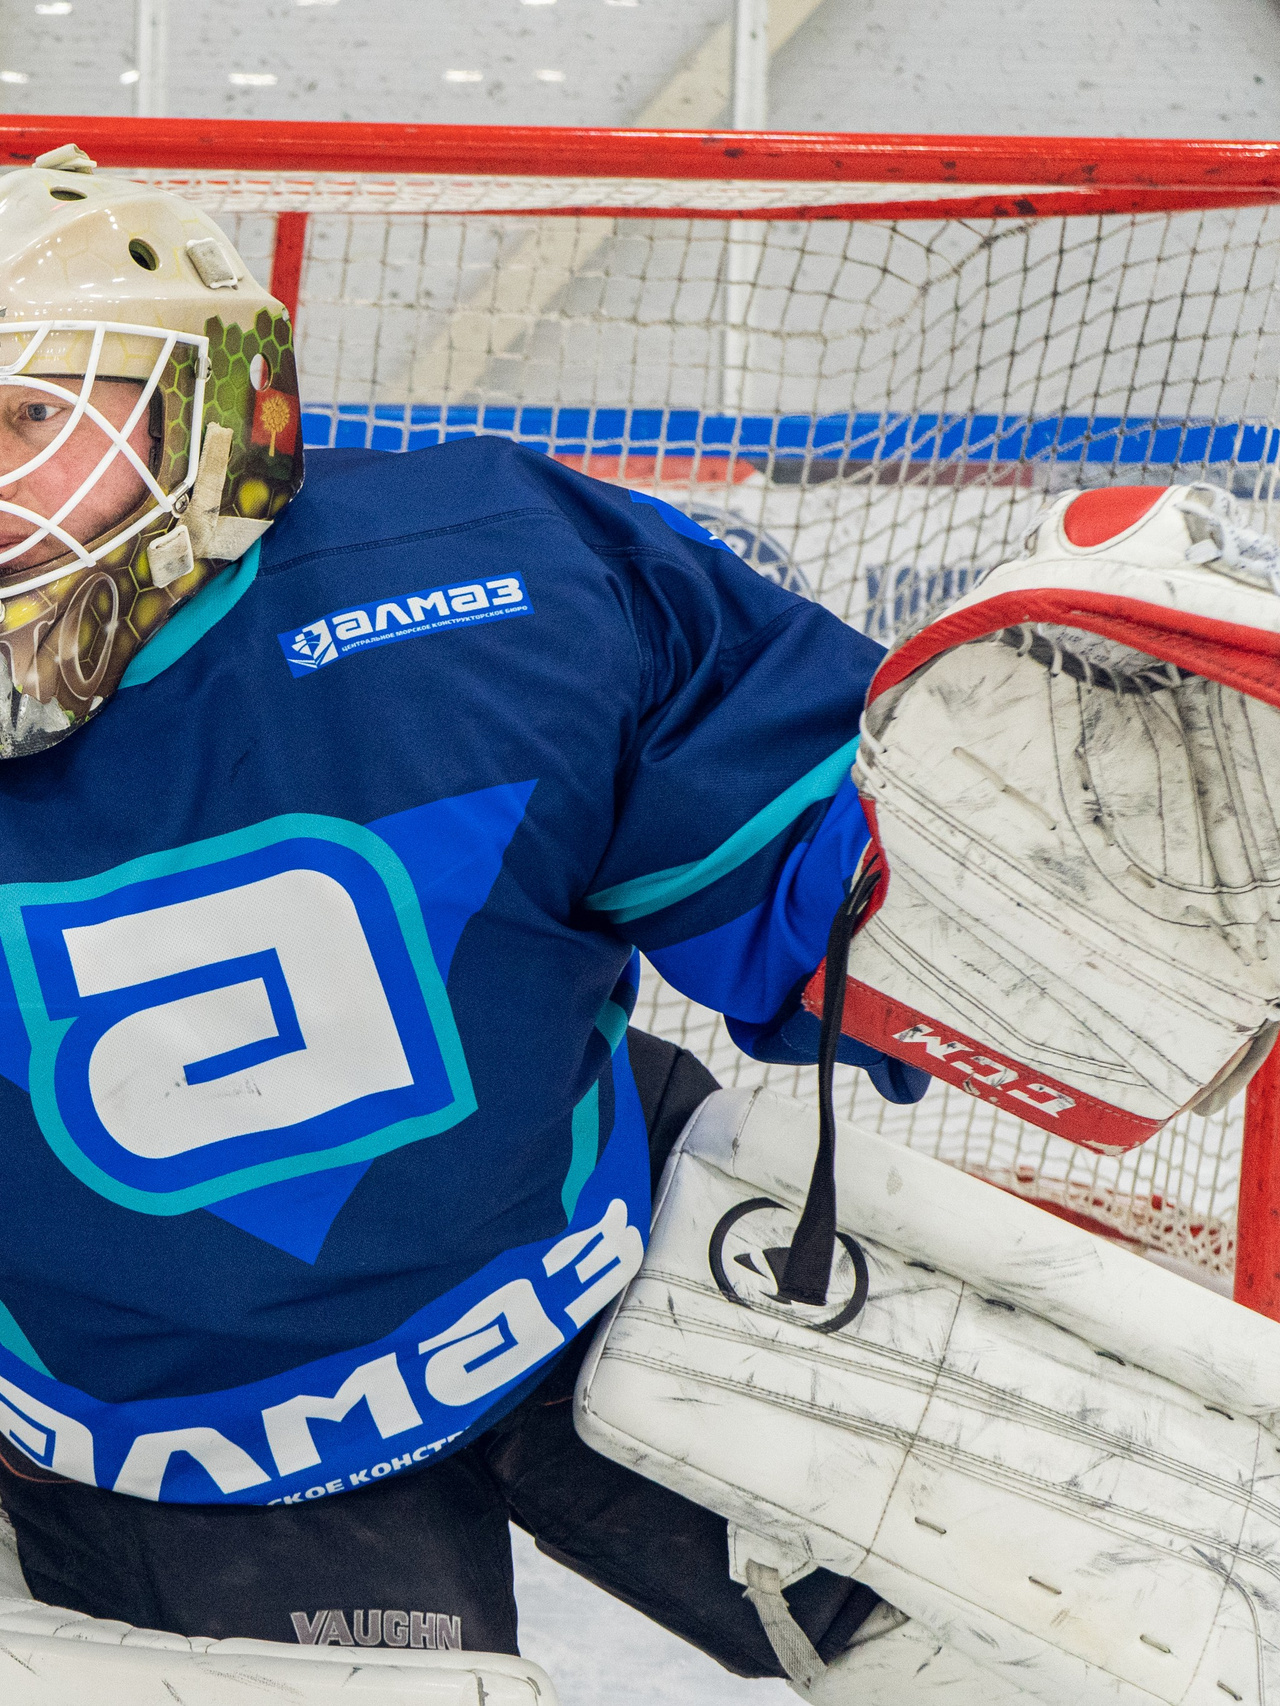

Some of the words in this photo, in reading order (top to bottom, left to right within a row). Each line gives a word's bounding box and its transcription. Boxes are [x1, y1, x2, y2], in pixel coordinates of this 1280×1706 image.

[341, 632, 395, 652] ЦЕНТРАЛЬНОЕ
[395, 622, 431, 637] МОРСКОЕ
[431, 610, 504, 628] КОНСТРУКТОРСКОЕ
[505, 605, 528, 615] БЮРО
[892, 1024, 1076, 1118] CCM
[289, 1609, 463, 1651] VAUGHN
